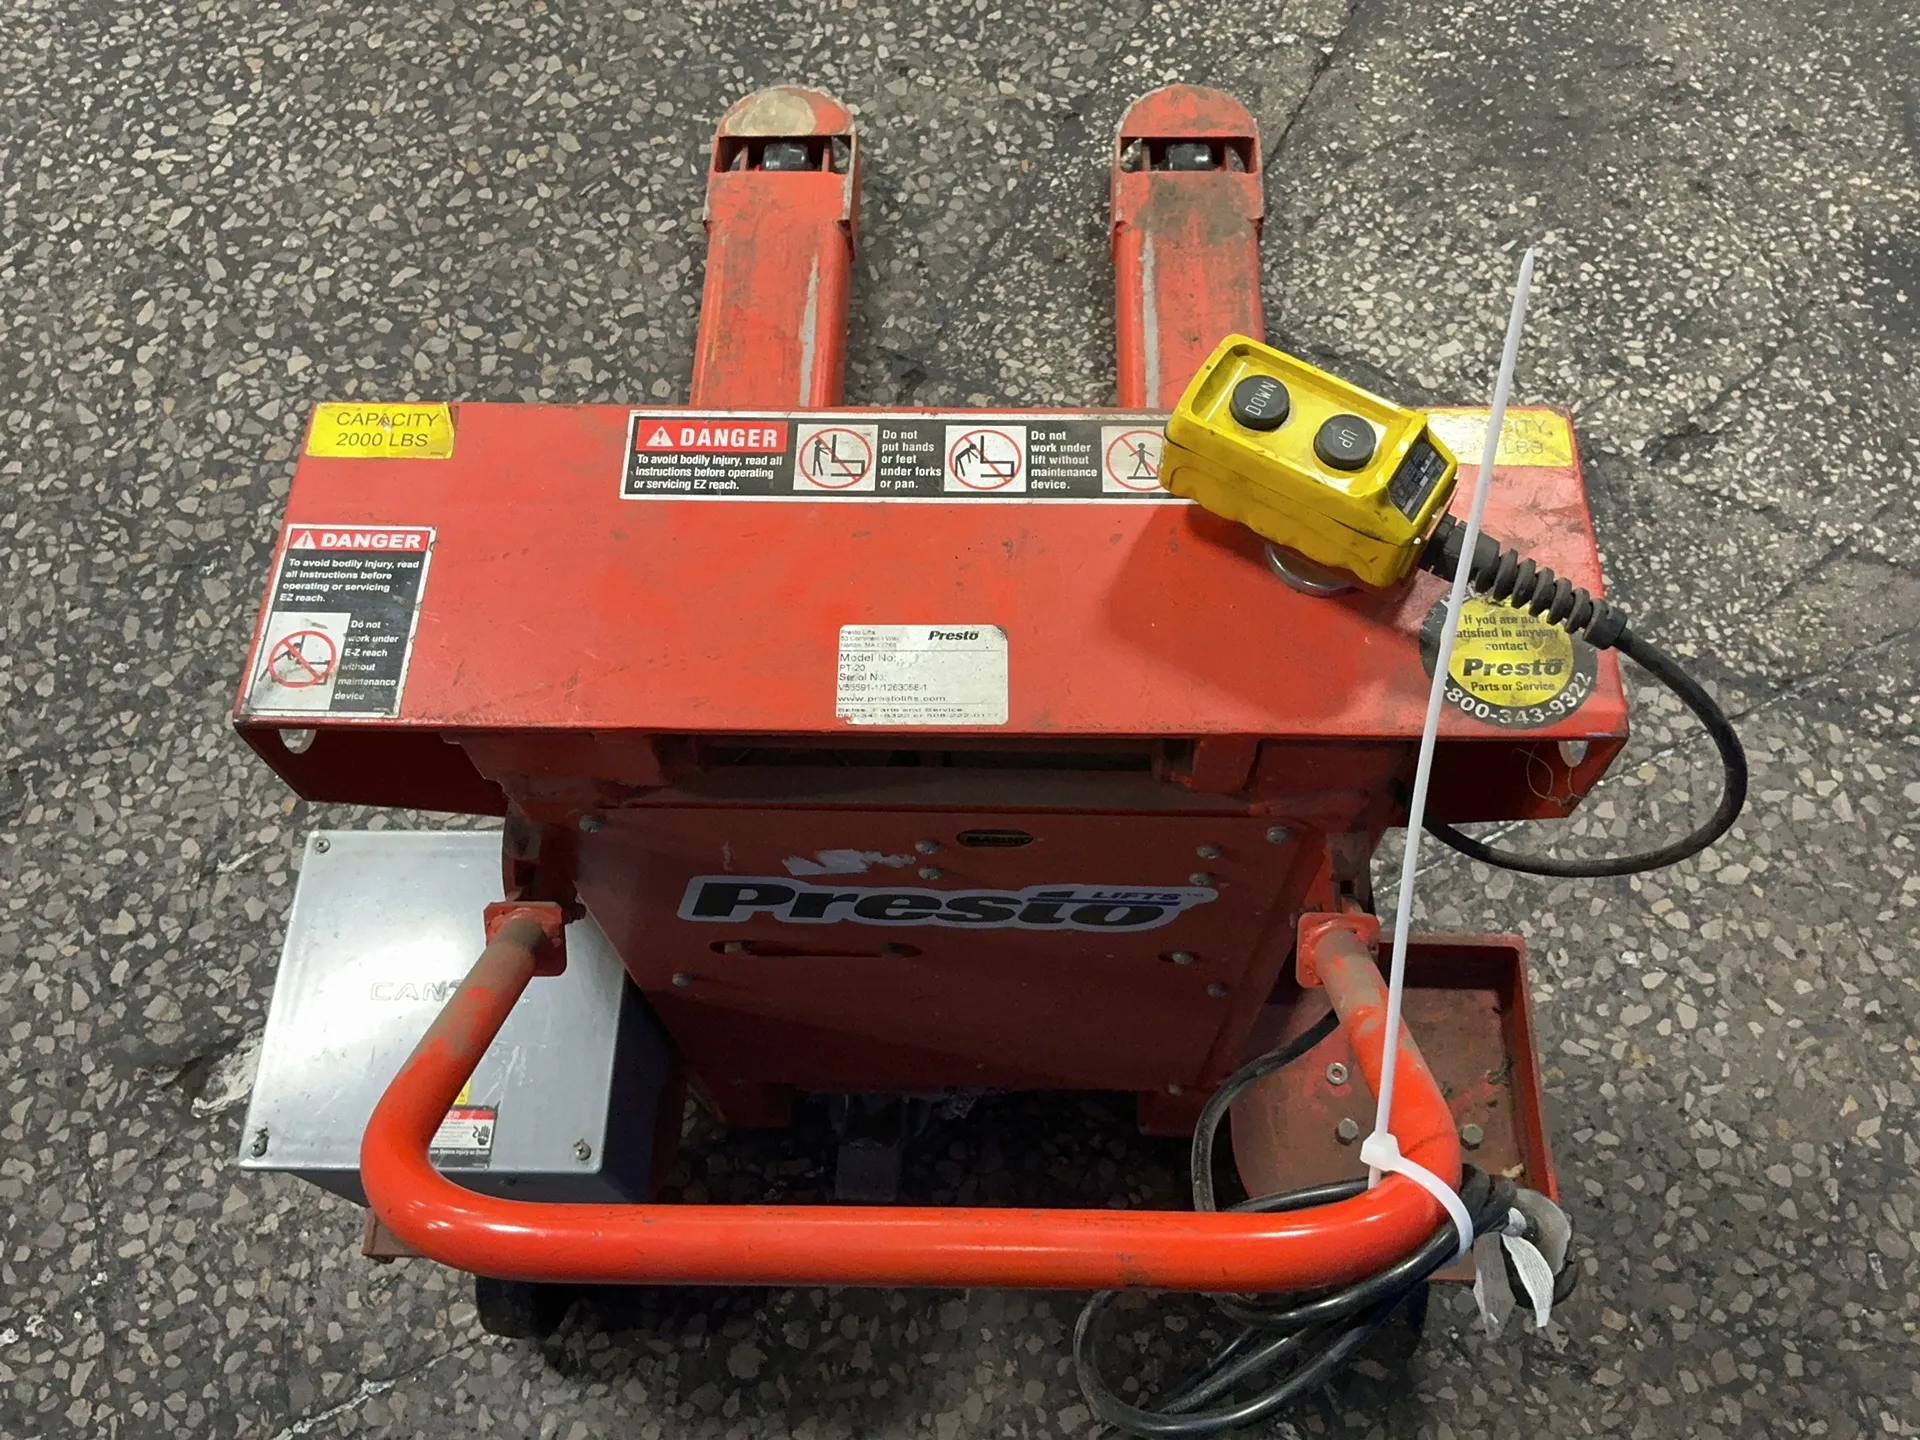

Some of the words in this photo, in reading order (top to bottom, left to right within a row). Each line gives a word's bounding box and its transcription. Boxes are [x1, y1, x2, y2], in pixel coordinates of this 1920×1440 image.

[1244, 380, 1277, 416] DOWN
[336, 411, 440, 428] CAPACITY
[336, 432, 384, 448] 2000
[388, 433, 429, 448] LBS
[680, 427, 778, 448] DANGER
[882, 429, 898, 440] Do
[900, 430, 918, 440] not
[1031, 430, 1047, 441] Do
[1049, 431, 1066, 441] not
[1338, 428, 1358, 448] UP
[881, 442, 900, 454] put
[902, 441, 935, 452] hands
[1031, 442, 1057, 453] work
[1060, 443, 1091, 453] under
[637, 454, 650, 465] To
[650, 454, 679, 465] avoid
[680, 454, 711, 467] bodily
[712, 455, 743, 468] injury,
[745, 455, 769, 466] read
[770, 455, 783, 466] all
[881, 456, 894, 464] or
[895, 454, 917, 464] feet
[1031, 455, 1047, 465] lift
[1049, 455, 1089, 465] without
[635, 466, 692, 477] instructions
[694, 467, 726, 478] before
[728, 468, 774, 480] operating
[880, 466, 912, 477] under
[915, 466, 942, 477] forks
[1031, 467, 1098, 478] maintenance
[633, 481, 645, 489] or
[646, 479, 692, 491] servicing
[694, 480, 707, 489] EZ
[708, 480, 740, 490] reach.
[880, 480, 893, 488] or
[894, 480, 919, 491] pan.
[1031, 479, 1070, 490] device.
[320, 533, 422, 549] DANGER
[289, 558, 301, 567] To
[303, 558, 330, 567] avoid
[332, 559, 363, 569] bodily
[364, 560, 395, 570] injury,
[397, 561, 420, 569] read
[285, 570, 298, 579] all
[299, 570, 358, 579] instructions
[360, 571, 393, 580] before
[282, 582, 330, 592] operating
[345, 583, 391, 593] servicing
[279, 594, 293, 602] EZ
[295, 594, 326, 602] reach.
[350, 620, 364, 628] Do
[365, 621, 381, 629] not
[1463, 614, 1472, 624] If
[1475, 615, 1496, 627] you
[1500, 615, 1520, 624] are
[348, 634, 370, 643] work
[372, 635, 399, 643] under
[928, 630, 979, 641] Presto
[1456, 628, 1498, 638] atisfied
[1501, 628, 1512, 638] in
[1485, 641, 1529, 651] contact
[344, 648, 361, 657] E-Z
[362, 649, 388, 657] reach
[839, 653, 874, 662] Model
[341, 663, 376, 671] without
[1462, 657, 1564, 677] Presto
[338, 678, 396, 686] maintenance
[838, 672, 867, 681] Seral
[1471, 681, 1500, 692] Parts
[1502, 683, 1512, 691] or
[1515, 681, 1556, 692] Service
[334, 691, 365, 701] device
[692, 882, 1165, 928] Presto
[1091, 891, 1182, 901] LIFTS
